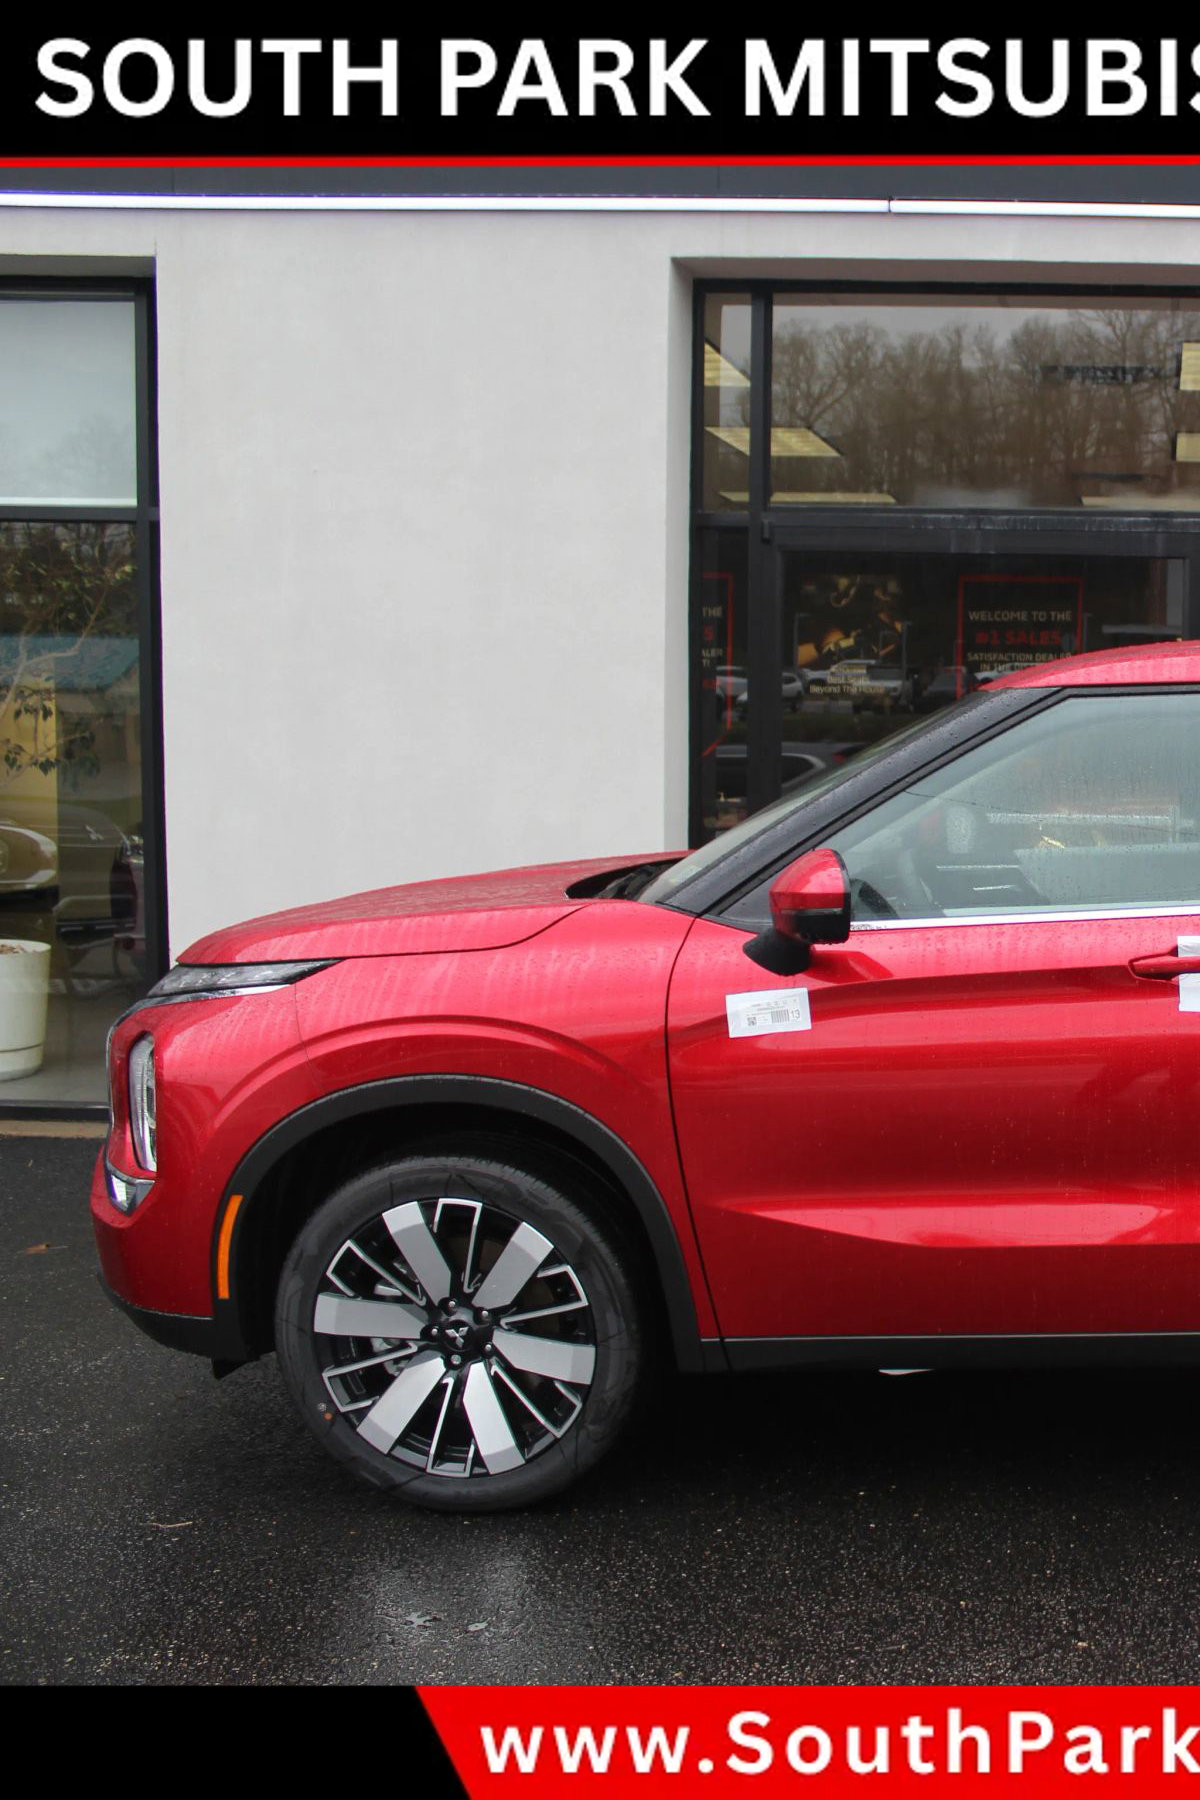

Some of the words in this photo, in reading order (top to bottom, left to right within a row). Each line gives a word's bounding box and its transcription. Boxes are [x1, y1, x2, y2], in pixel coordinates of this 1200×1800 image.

[968, 611, 1028, 622] WELCOME
[1031, 611, 1047, 621] TO
[1050, 611, 1073, 621] THE
[1005, 629, 1062, 645] SALES
[967, 652, 1033, 662] SATISFACTION
[810, 684, 840, 695] Beyond
